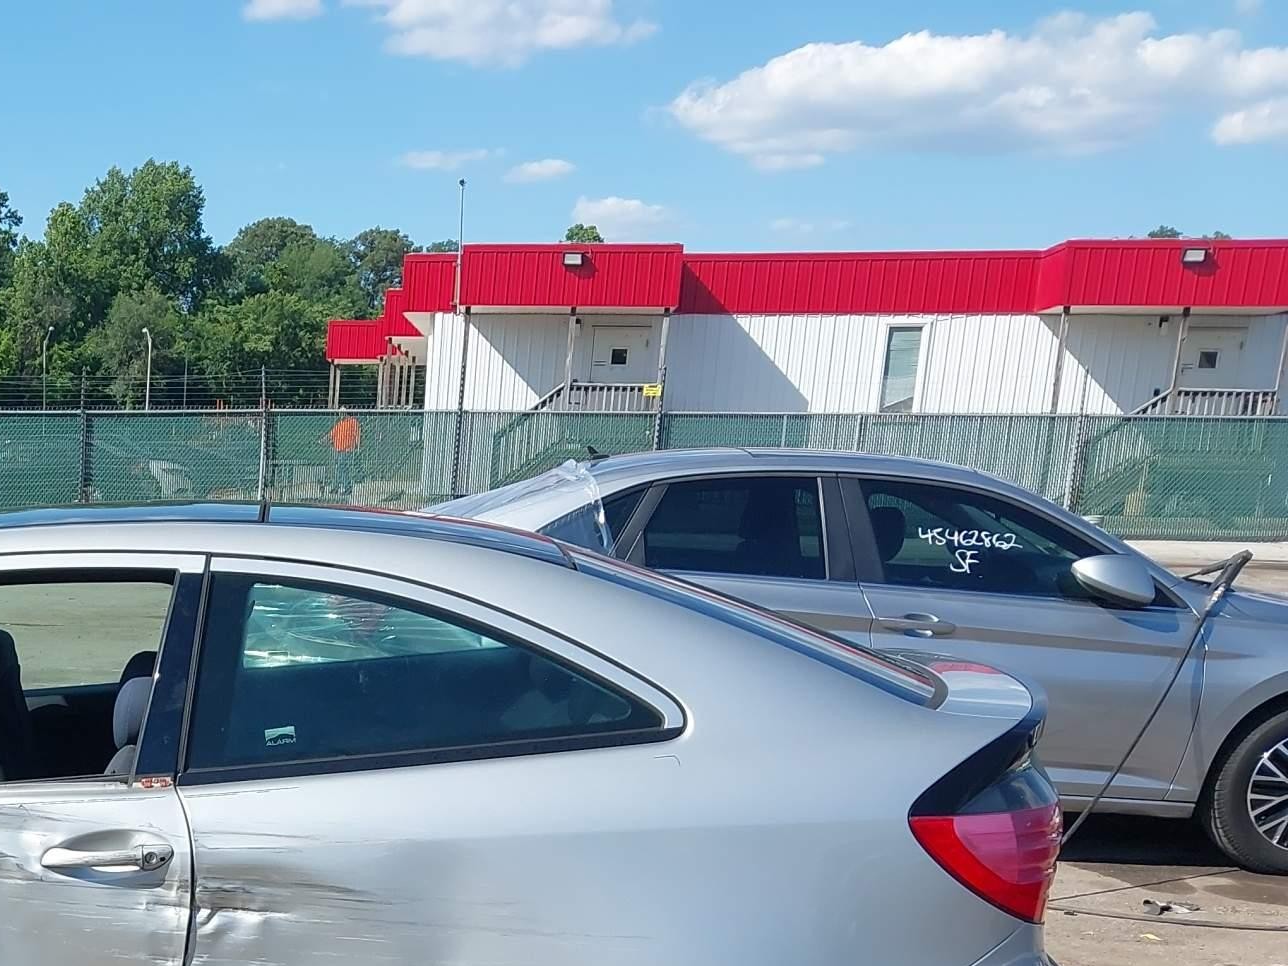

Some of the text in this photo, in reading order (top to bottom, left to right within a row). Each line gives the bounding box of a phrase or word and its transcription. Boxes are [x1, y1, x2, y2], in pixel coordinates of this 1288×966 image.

[918, 527, 1023, 549] 45462862
[950, 549, 980, 574] SF
[265, 738, 297, 747] ALARM
